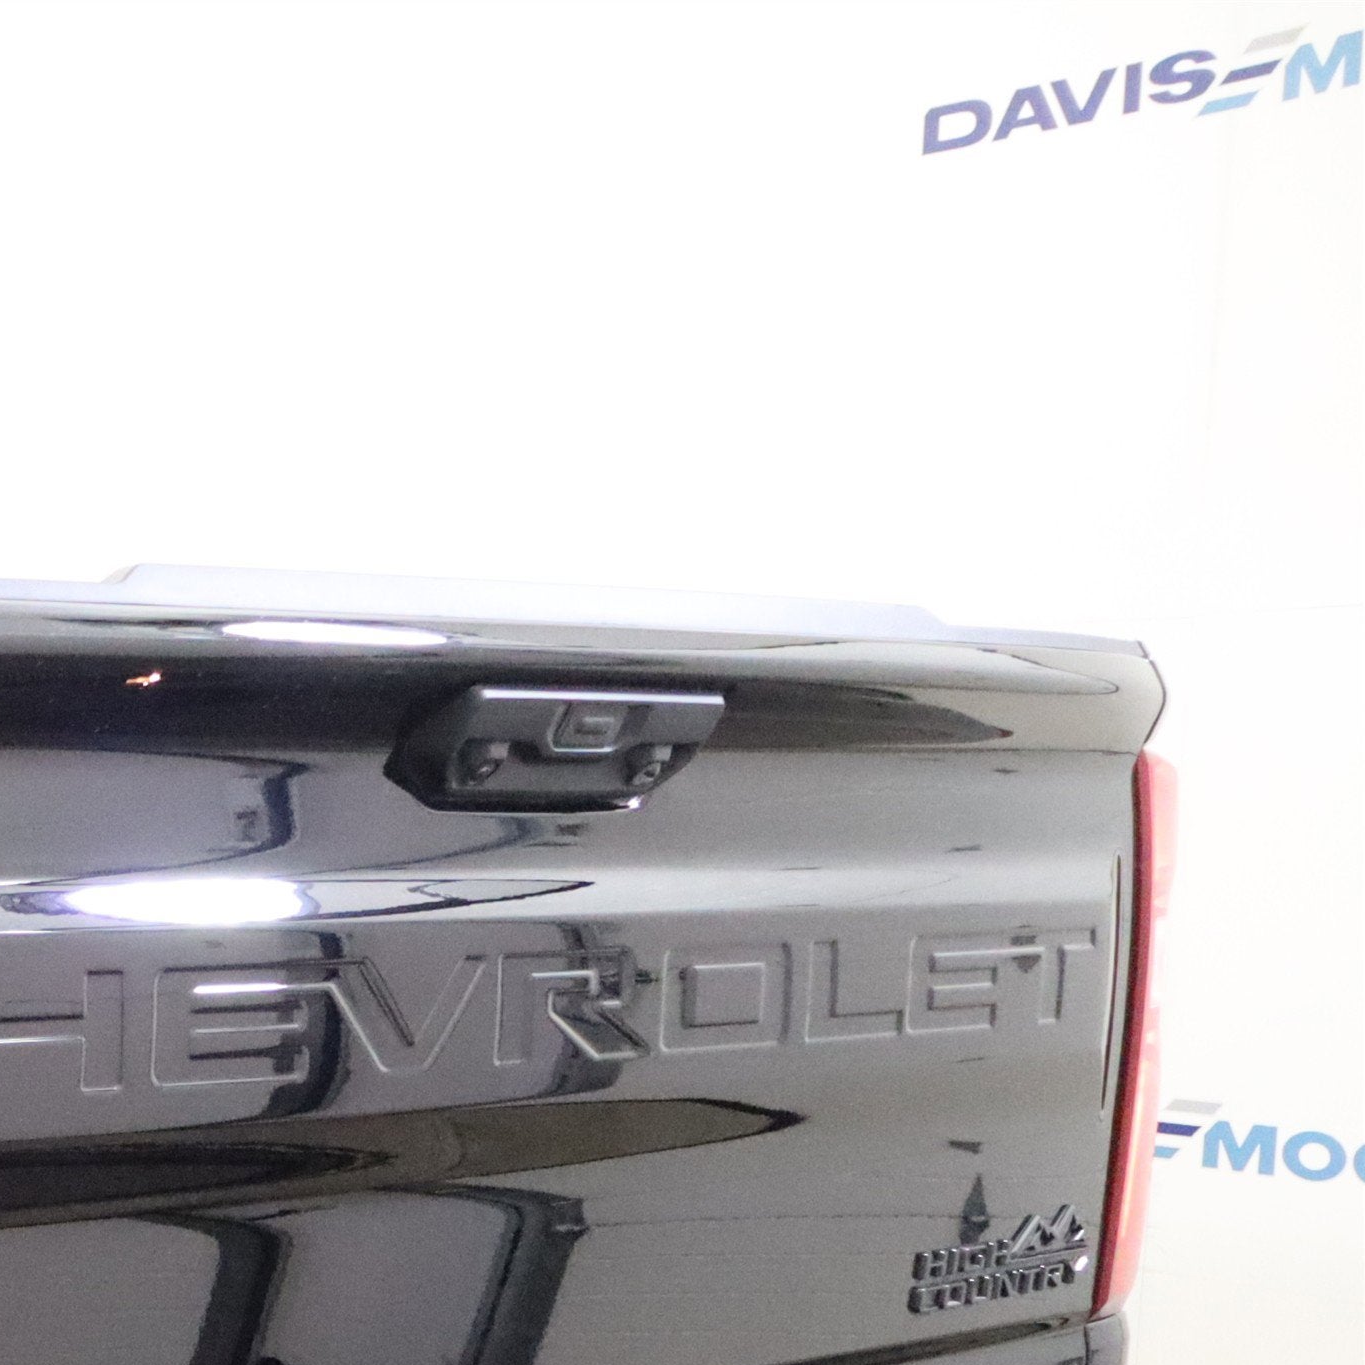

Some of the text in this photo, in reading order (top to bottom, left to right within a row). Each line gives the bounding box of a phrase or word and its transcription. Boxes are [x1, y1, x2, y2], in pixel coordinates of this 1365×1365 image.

[922, 48, 1217, 155] DAVIS
[907, 1255, 1089, 1314] COUNTRY
[912, 1239, 1010, 1281] HIGH
